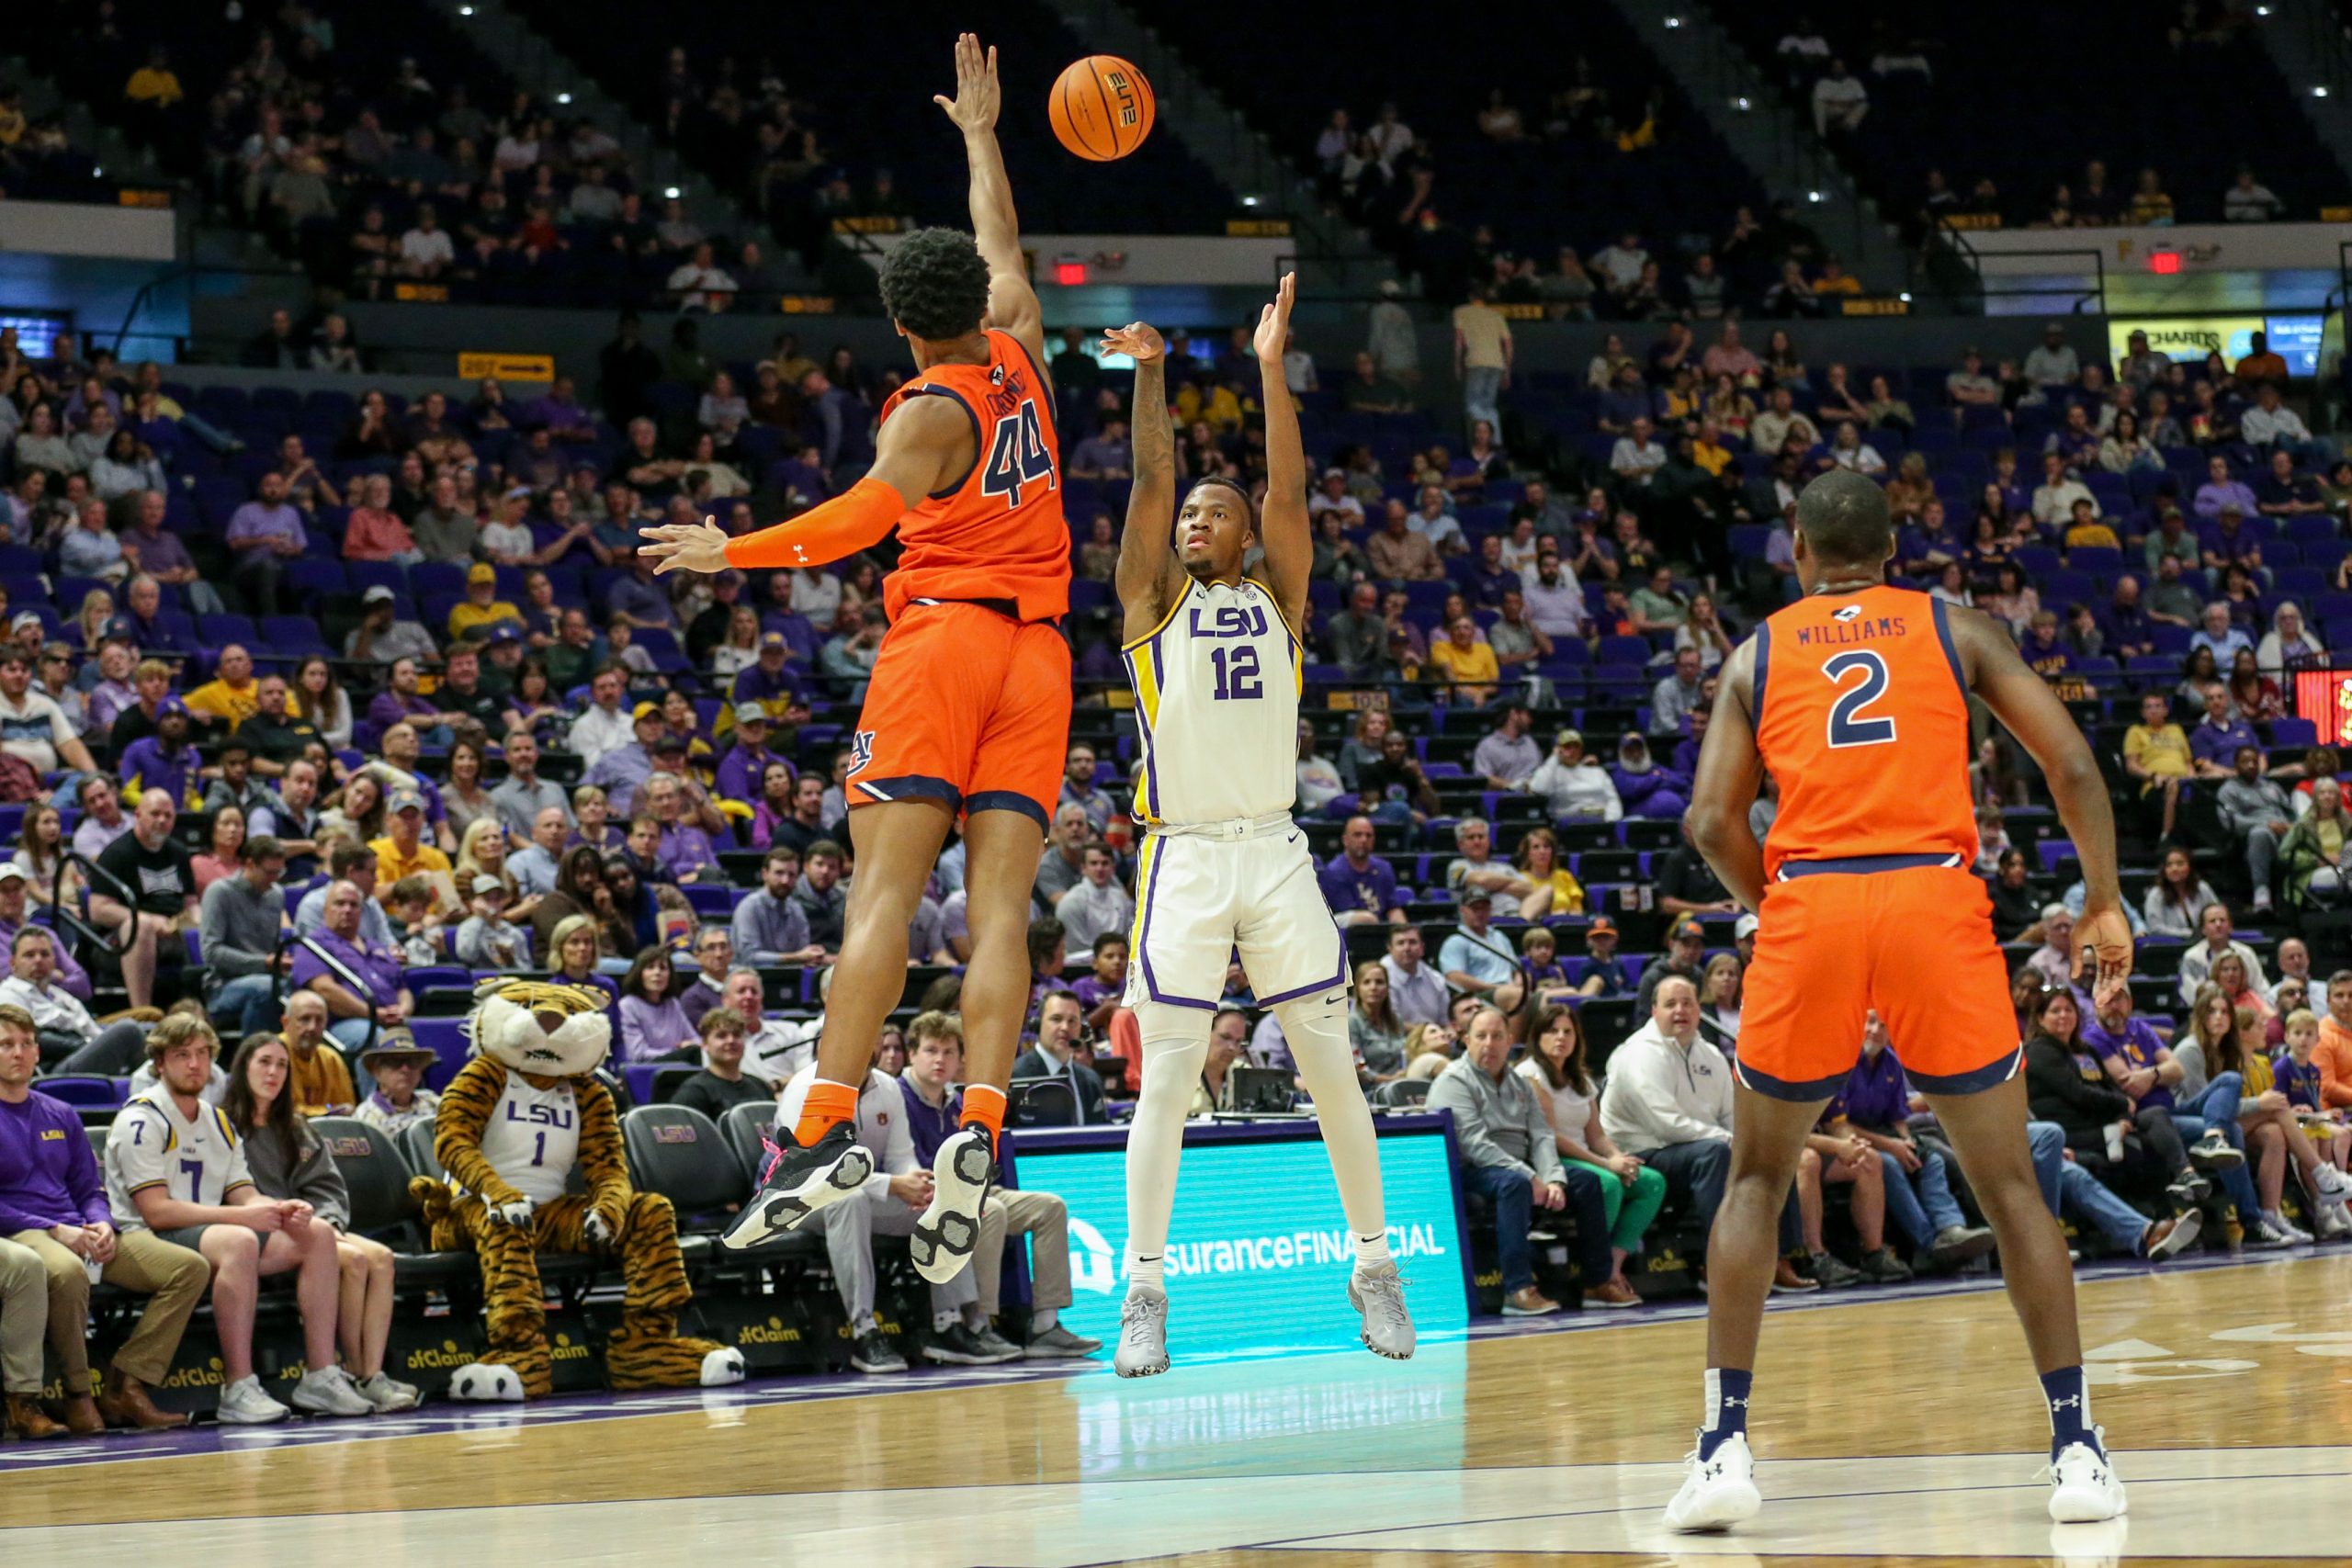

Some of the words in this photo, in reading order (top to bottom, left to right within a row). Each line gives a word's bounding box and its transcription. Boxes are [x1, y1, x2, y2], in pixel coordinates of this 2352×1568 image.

[981, 397, 1057, 511] 44
[1190, 605, 1268, 637] LSU
[1797, 617, 1906, 646] WILLIAMS
[1211, 646, 1262, 700] 12
[1821, 649, 1897, 749] 2
[507, 1100, 571, 1131] LSU
[130, 1121, 145, 1145] 7
[531, 1132, 545, 1167] 1
[651, 1125, 696, 1143] LSU
[180, 1158, 203, 1203] 7
